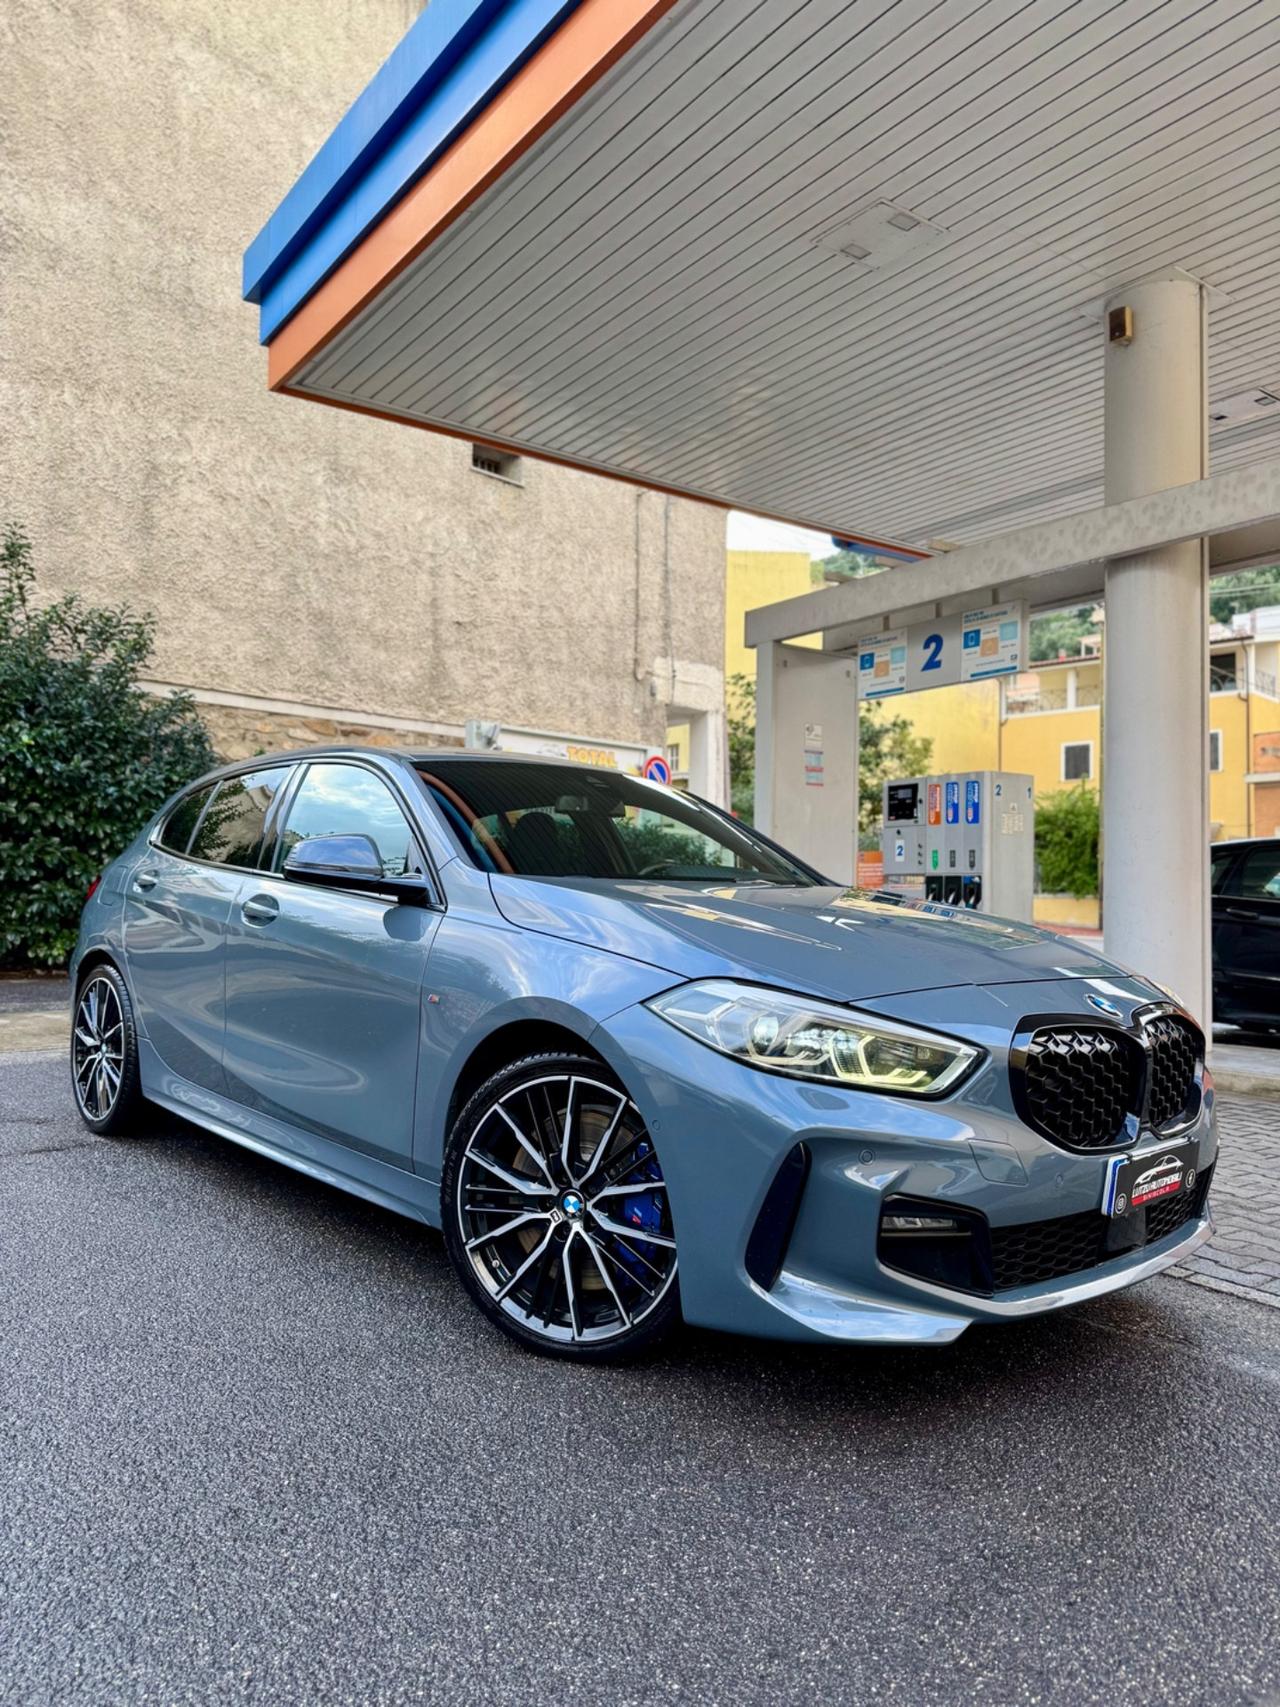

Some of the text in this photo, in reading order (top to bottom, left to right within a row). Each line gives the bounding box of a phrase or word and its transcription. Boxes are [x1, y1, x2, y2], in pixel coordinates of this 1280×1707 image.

[921, 634, 943, 672] 2
[567, 745, 618, 768] TOTAL
[995, 783, 1002, 796] 2
[1027, 786, 1032, 799] 1
[896, 845, 904, 857] 2
